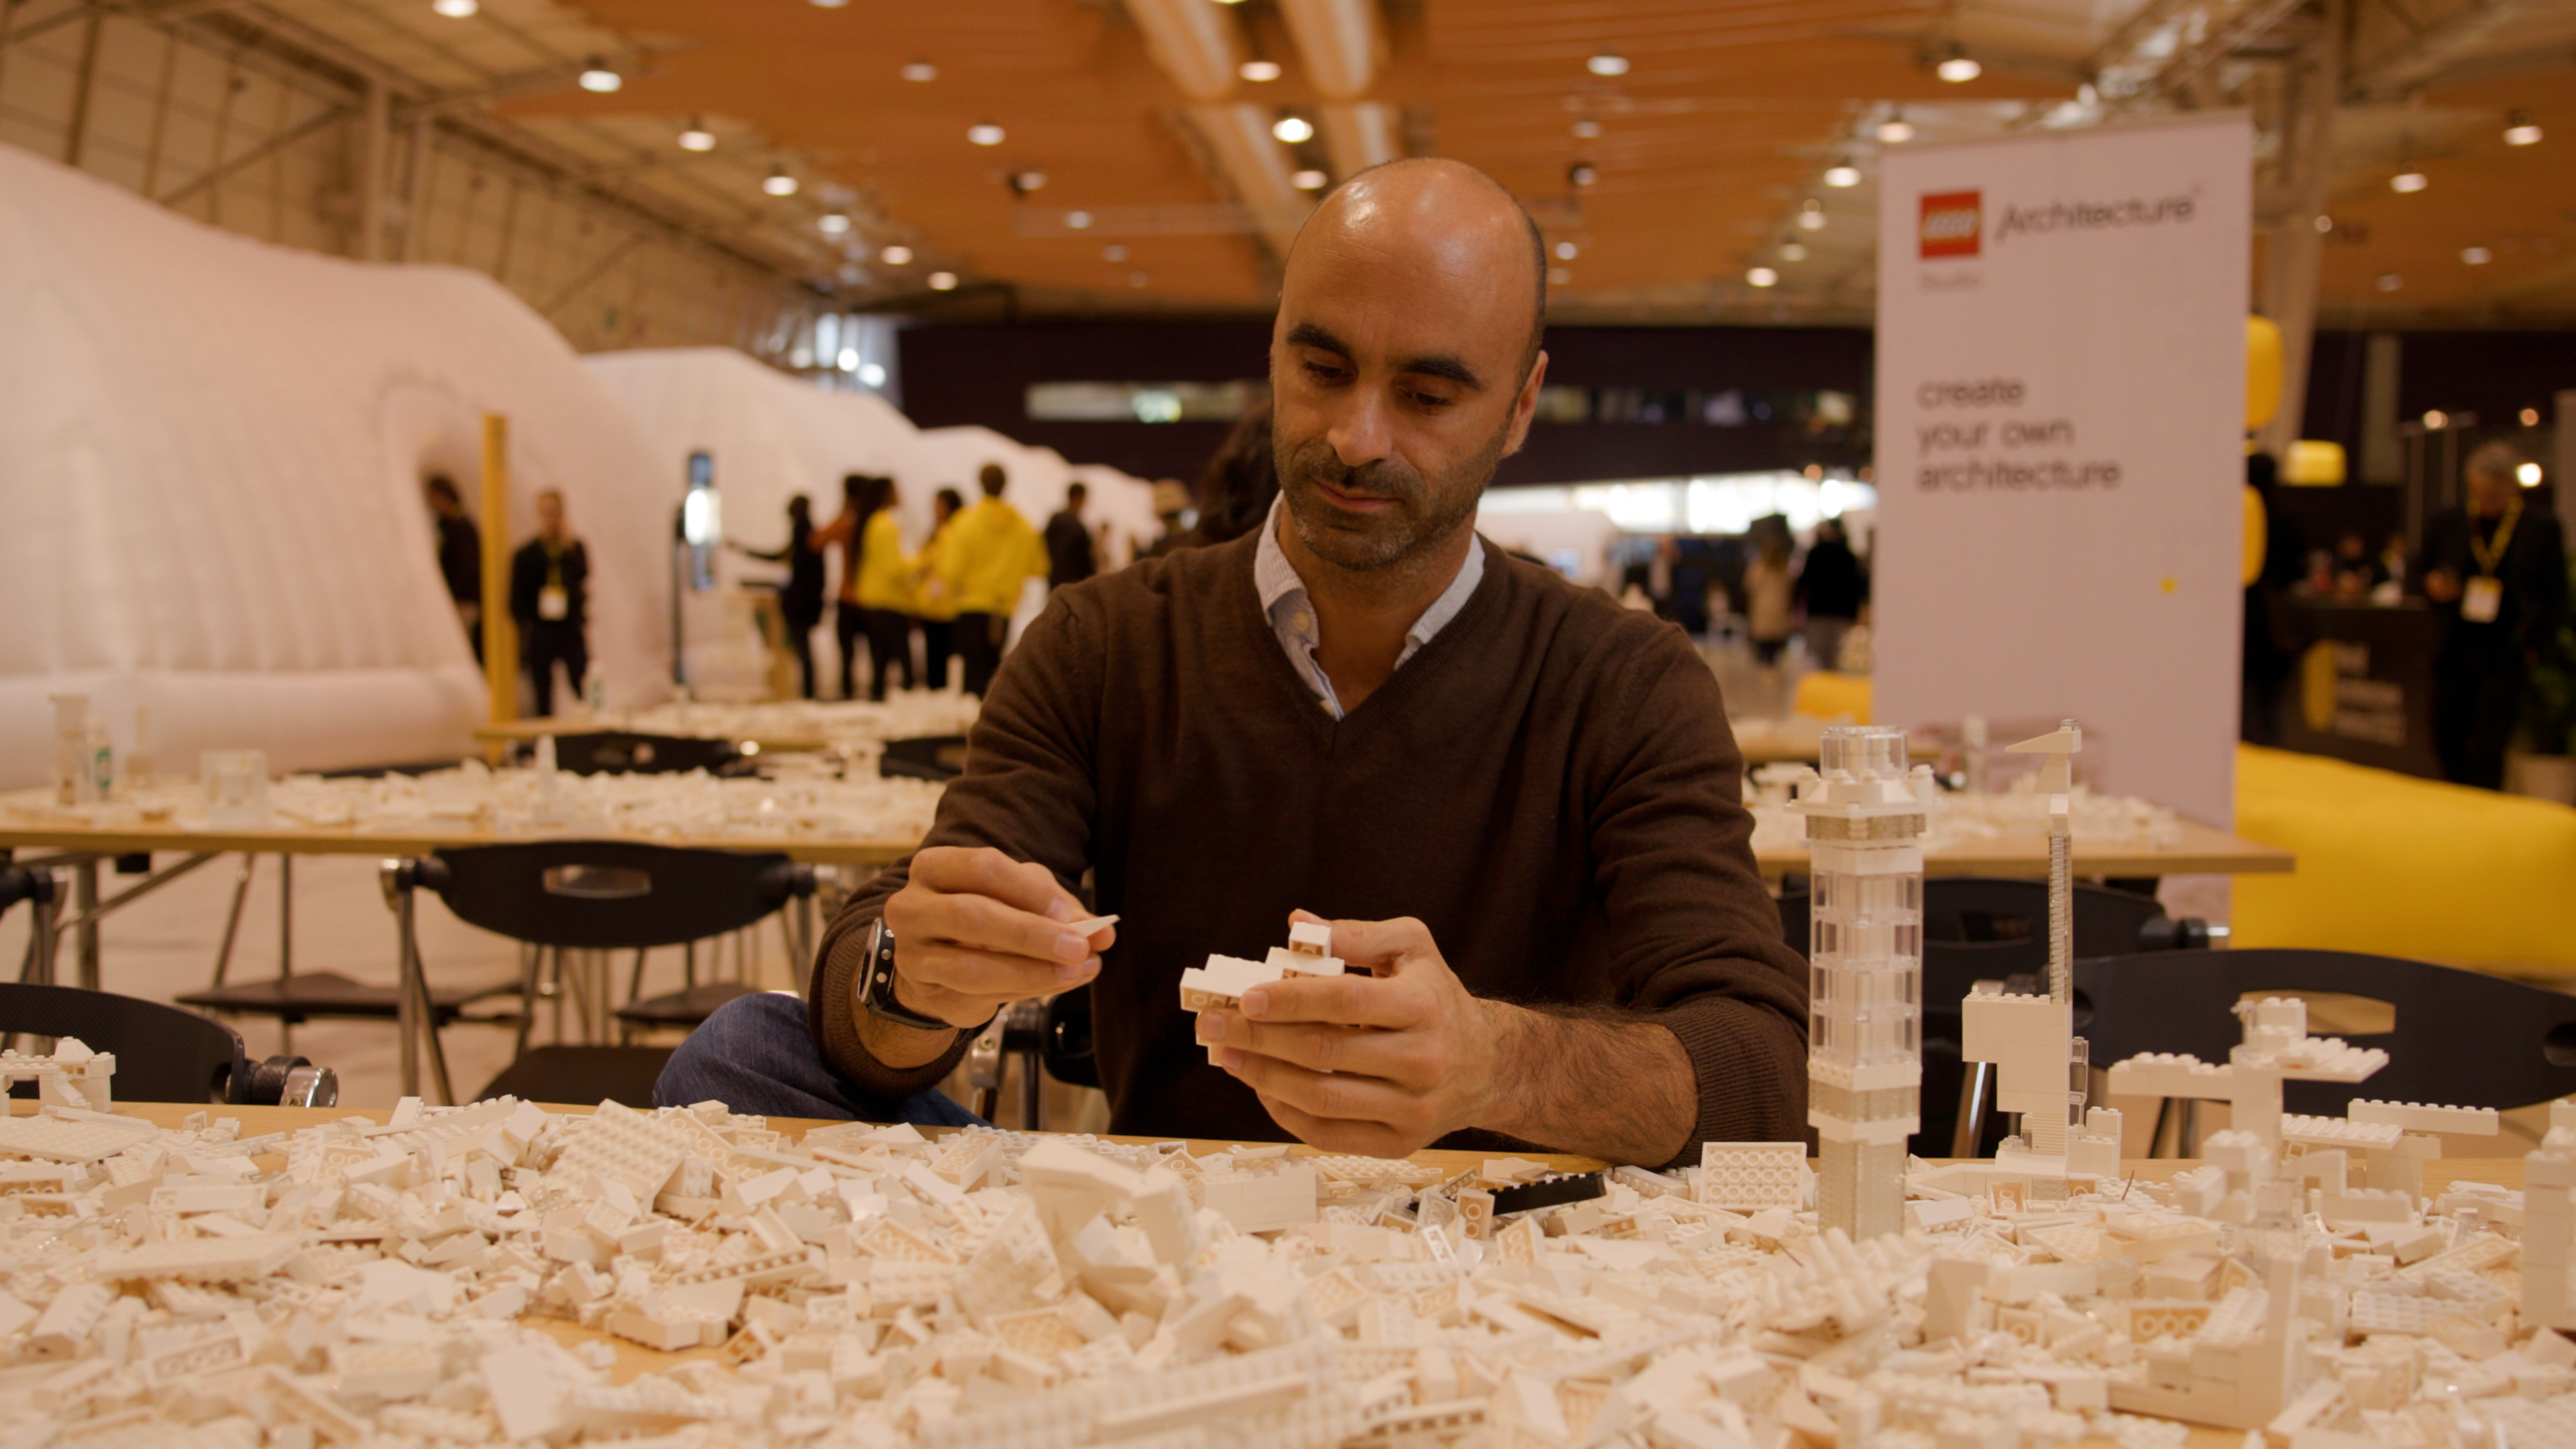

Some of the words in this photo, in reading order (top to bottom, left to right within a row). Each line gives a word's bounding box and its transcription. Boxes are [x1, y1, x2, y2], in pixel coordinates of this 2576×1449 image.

[1994, 197, 2196, 244] Architecture
[1917, 378, 2026, 409] create
[1917, 421, 1990, 456] your
[2000, 418, 2074, 448] own
[1917, 458, 2122, 490] architecture
